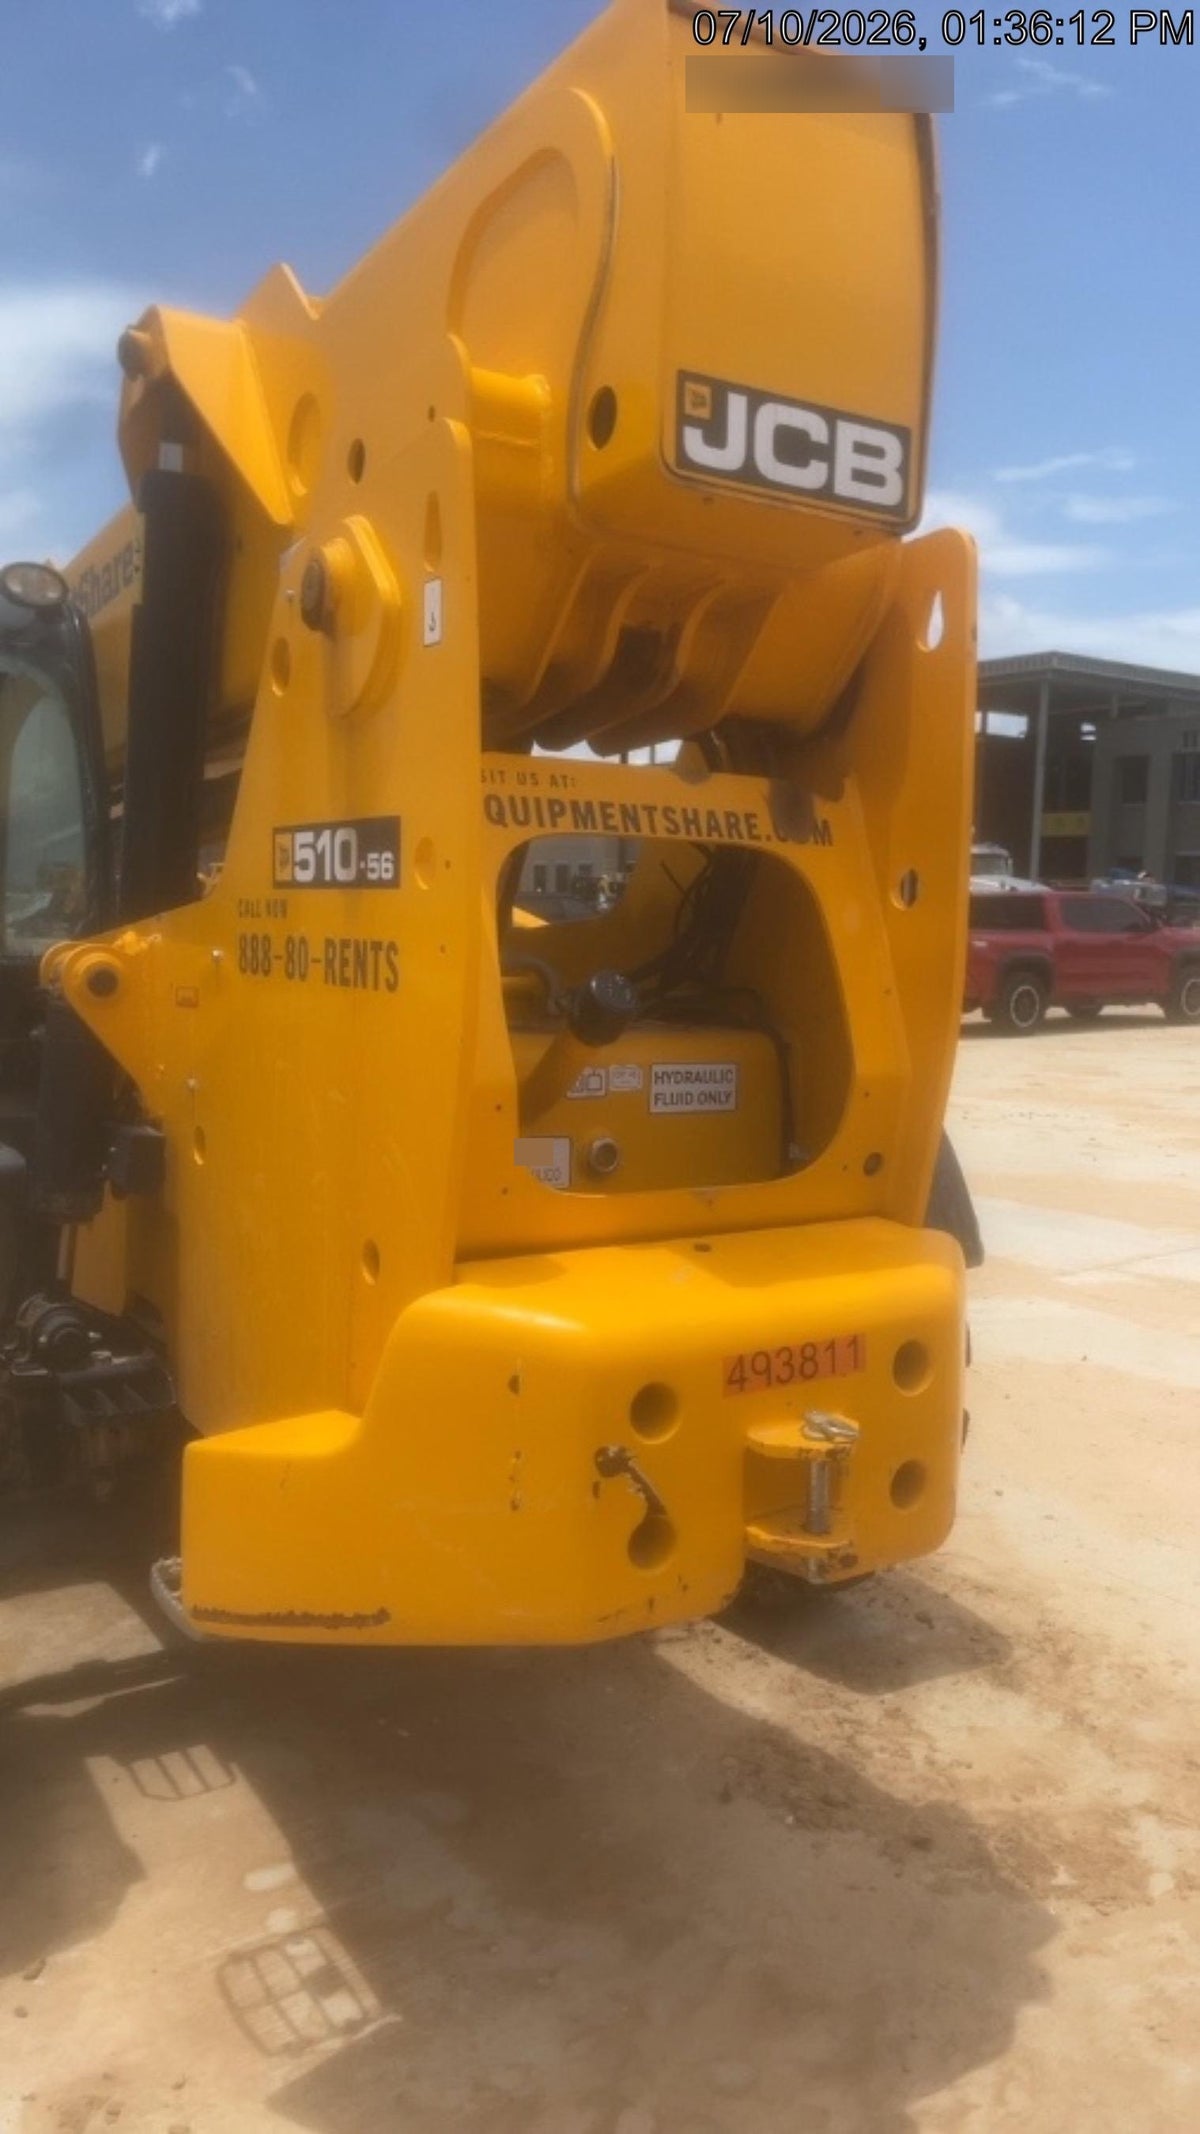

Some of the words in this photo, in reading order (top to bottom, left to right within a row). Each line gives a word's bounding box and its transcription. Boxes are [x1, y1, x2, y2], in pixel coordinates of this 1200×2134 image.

[682, 391, 904, 506] JCB
[516, 771, 540, 786] US
[549, 774, 576, 789] AT:
[483, 793, 834, 847] QUIPMENTSHARE.M
[238, 898, 262, 919] CALL
[265, 898, 288, 919] NOW
[238, 932, 400, 993] 888-80-RENTS
[653, 1068, 734, 1086] HYDRAULIC
[653, 1091, 694, 1107] FLUID
[696, 1090, 732, 1106] ONLY
[726, 1333, 860, 1393] 493811
